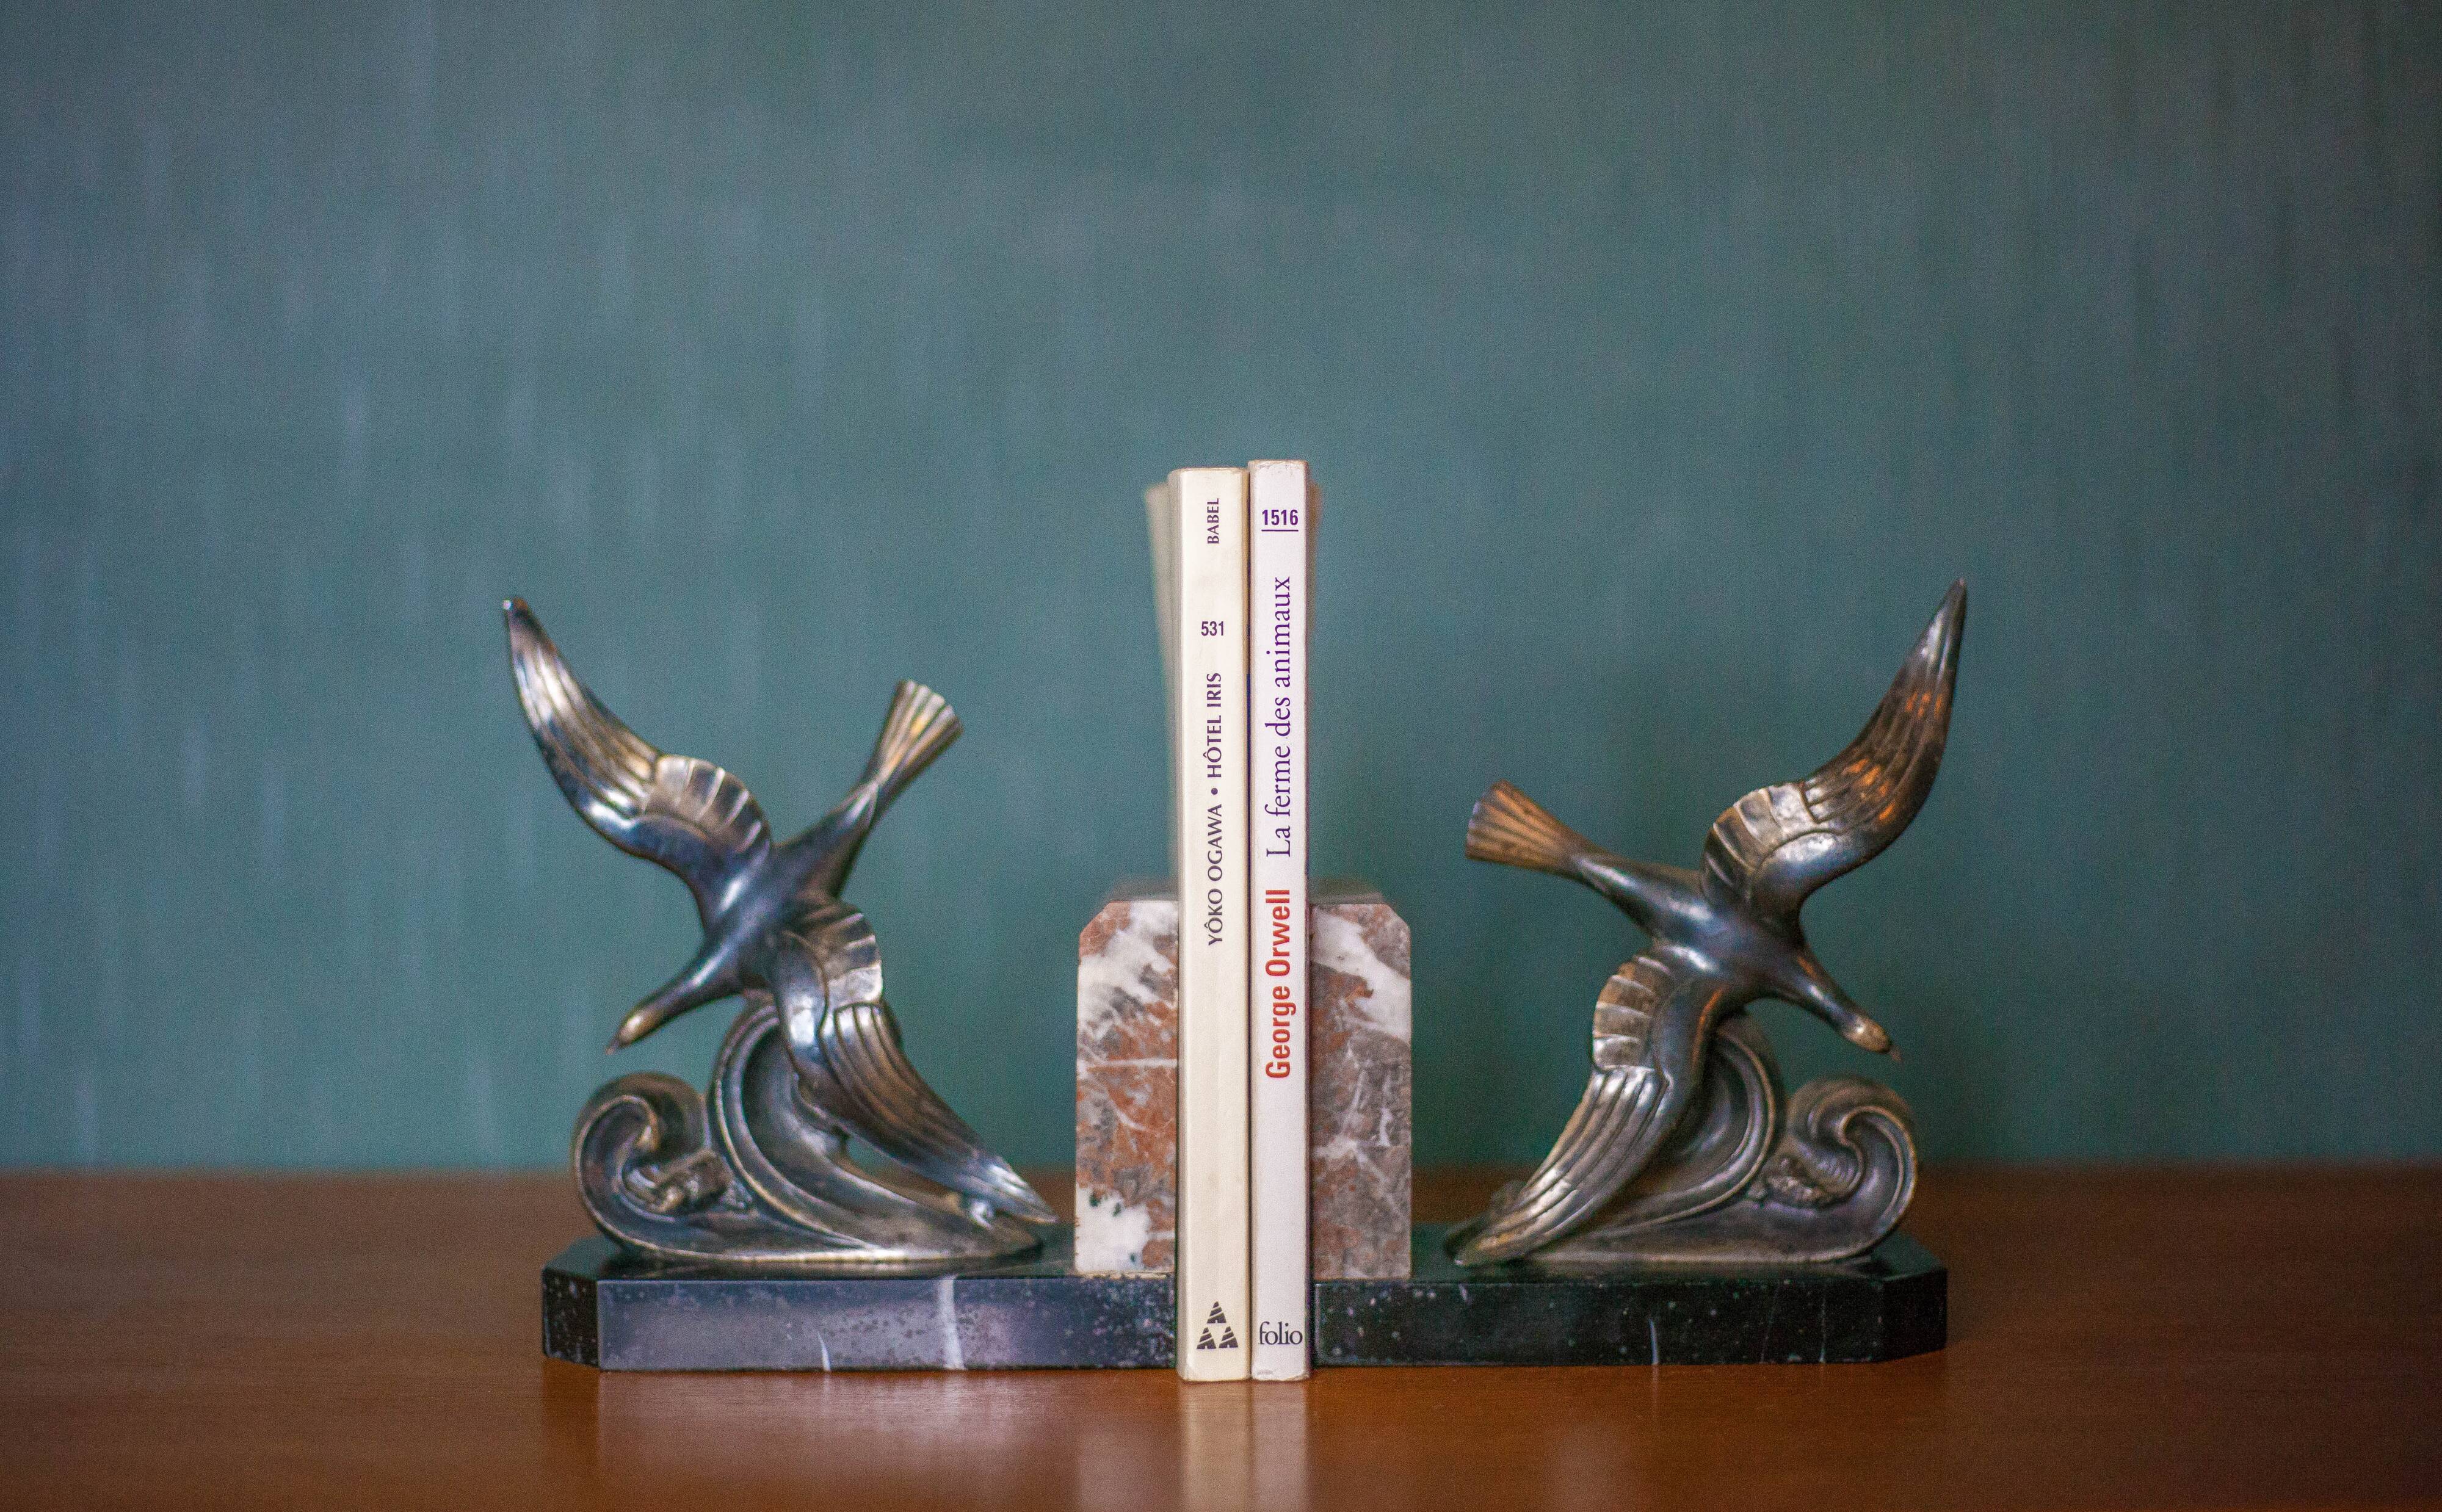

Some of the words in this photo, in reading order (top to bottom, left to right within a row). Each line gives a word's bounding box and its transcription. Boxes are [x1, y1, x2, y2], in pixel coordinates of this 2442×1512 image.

[1206, 497, 1220, 544] BABEL
[1261, 509, 1299, 526] 1516
[1201, 621, 1225, 637] 531
[1266, 576, 1291, 689] animaux
[1206, 672, 1222, 708] IRIS
[1264, 697, 1291, 737] des
[1203, 715, 1222, 778] HÔTEL
[1264, 746, 1291, 817] ferme
[1206, 804, 1223, 882] OGAWA
[1264, 825, 1291, 858] La
[1203, 888, 1223, 947] YÔKO
[1264, 889, 1291, 977] Orwell
[1264, 985, 1297, 1079] George
[1258, 1320, 1304, 1346] folio
